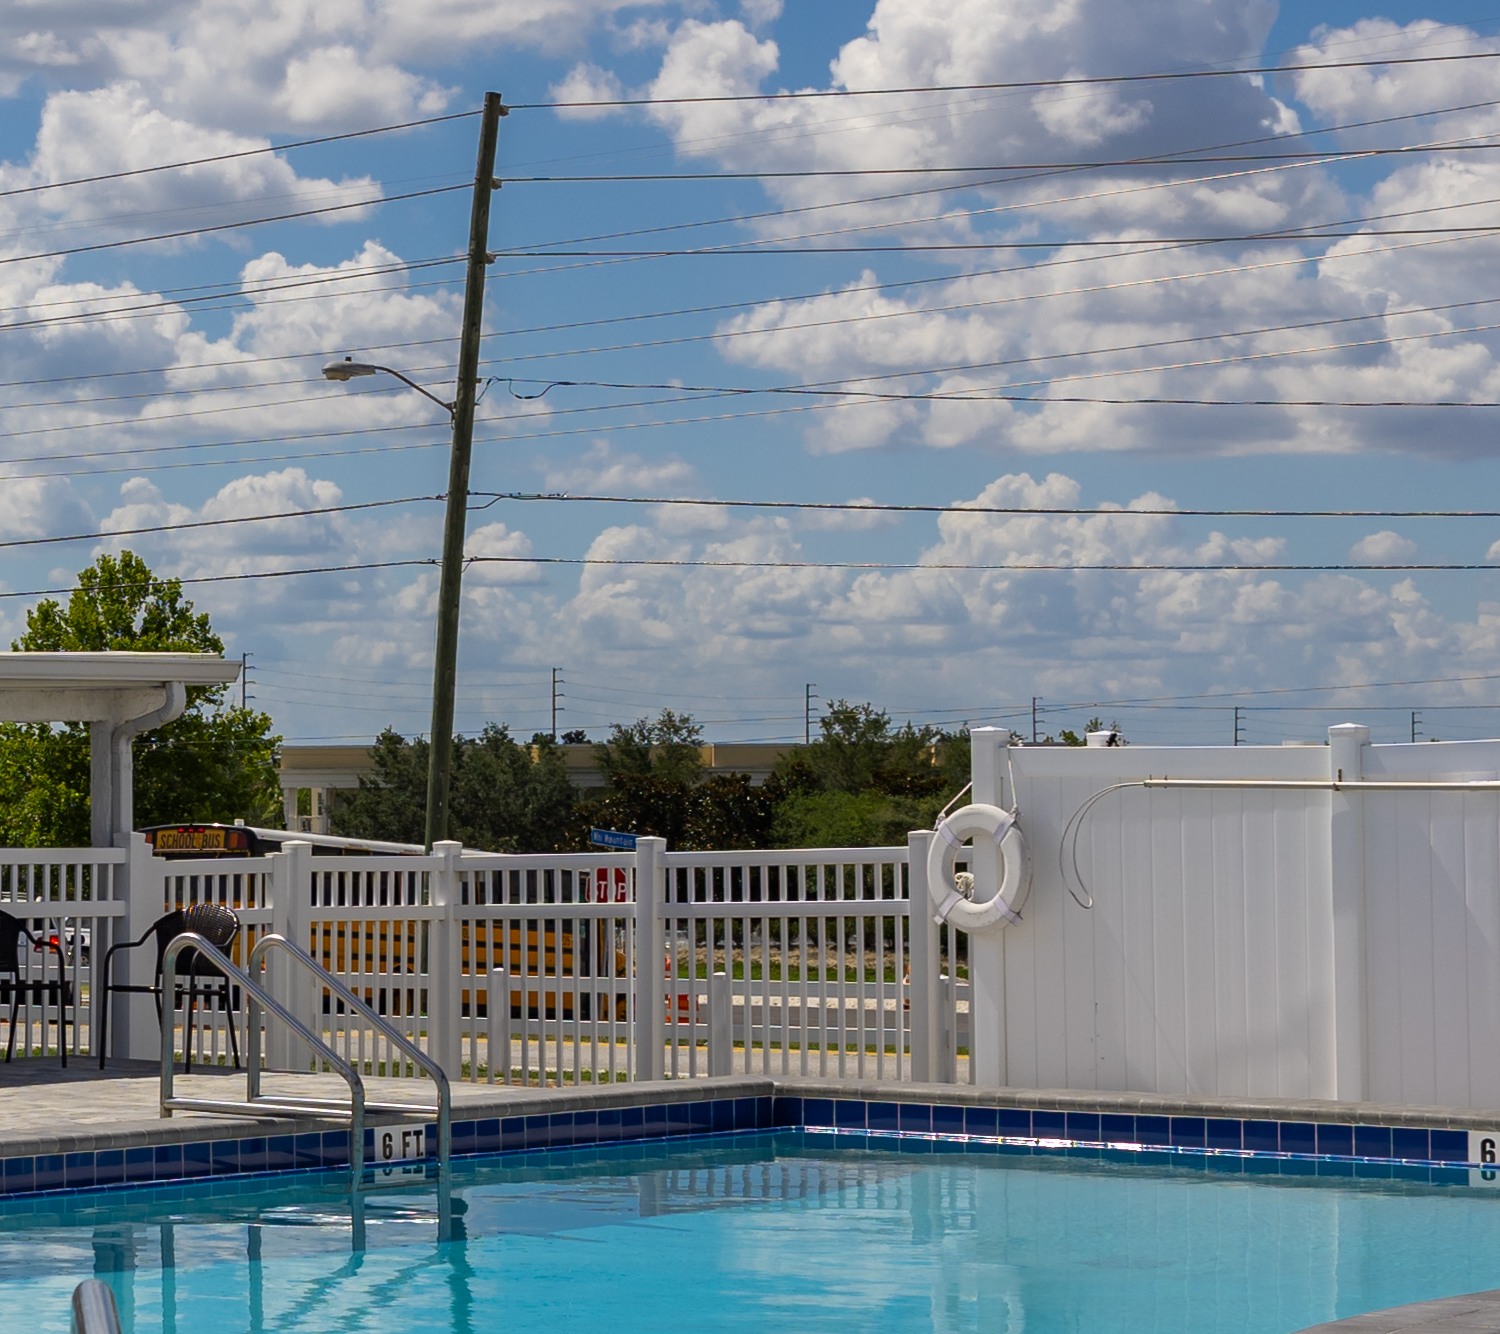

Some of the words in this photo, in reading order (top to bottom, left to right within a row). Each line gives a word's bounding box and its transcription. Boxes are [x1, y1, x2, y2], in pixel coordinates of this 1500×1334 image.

[160, 833, 196, 848] SCHOOL
[202, 833, 220, 848] BUS
[382, 1132, 393, 1160] 6
[402, 1129, 423, 1158] FT.
[1480, 1138, 1496, 1164] 6
